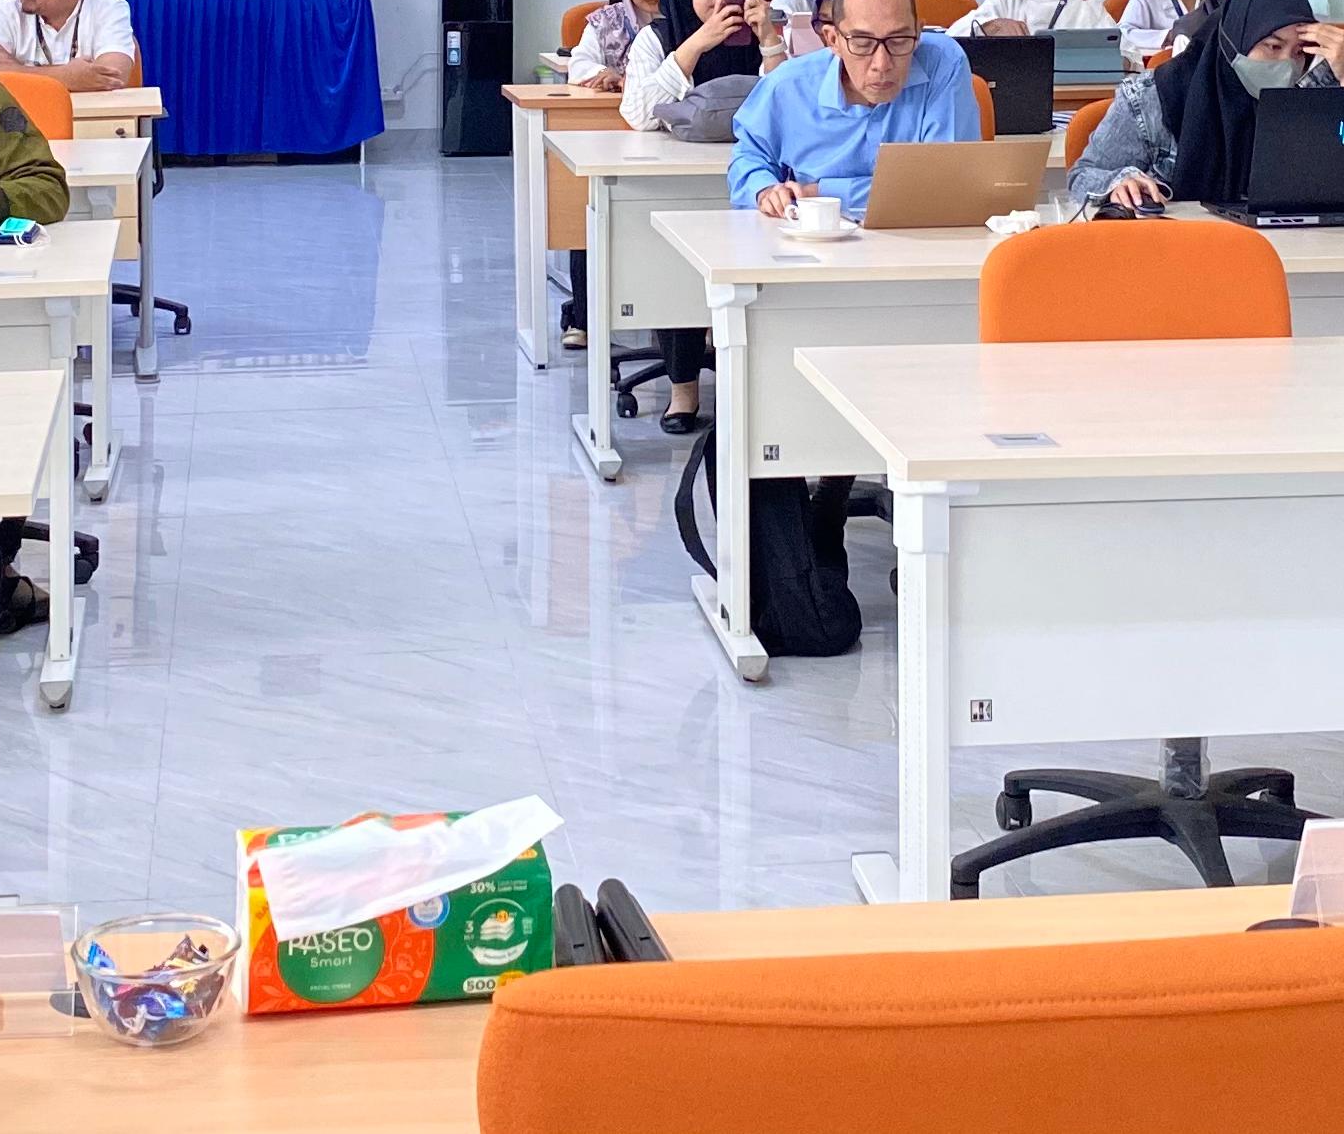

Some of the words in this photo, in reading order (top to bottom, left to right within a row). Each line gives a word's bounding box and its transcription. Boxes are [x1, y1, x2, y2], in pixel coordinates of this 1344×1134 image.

[470, 879, 496, 894] 30%
[465, 920, 474, 933] 3
[288, 928, 374, 956] PASEO
[310, 956, 353, 968] Smart
[466, 979, 496, 992] 500
